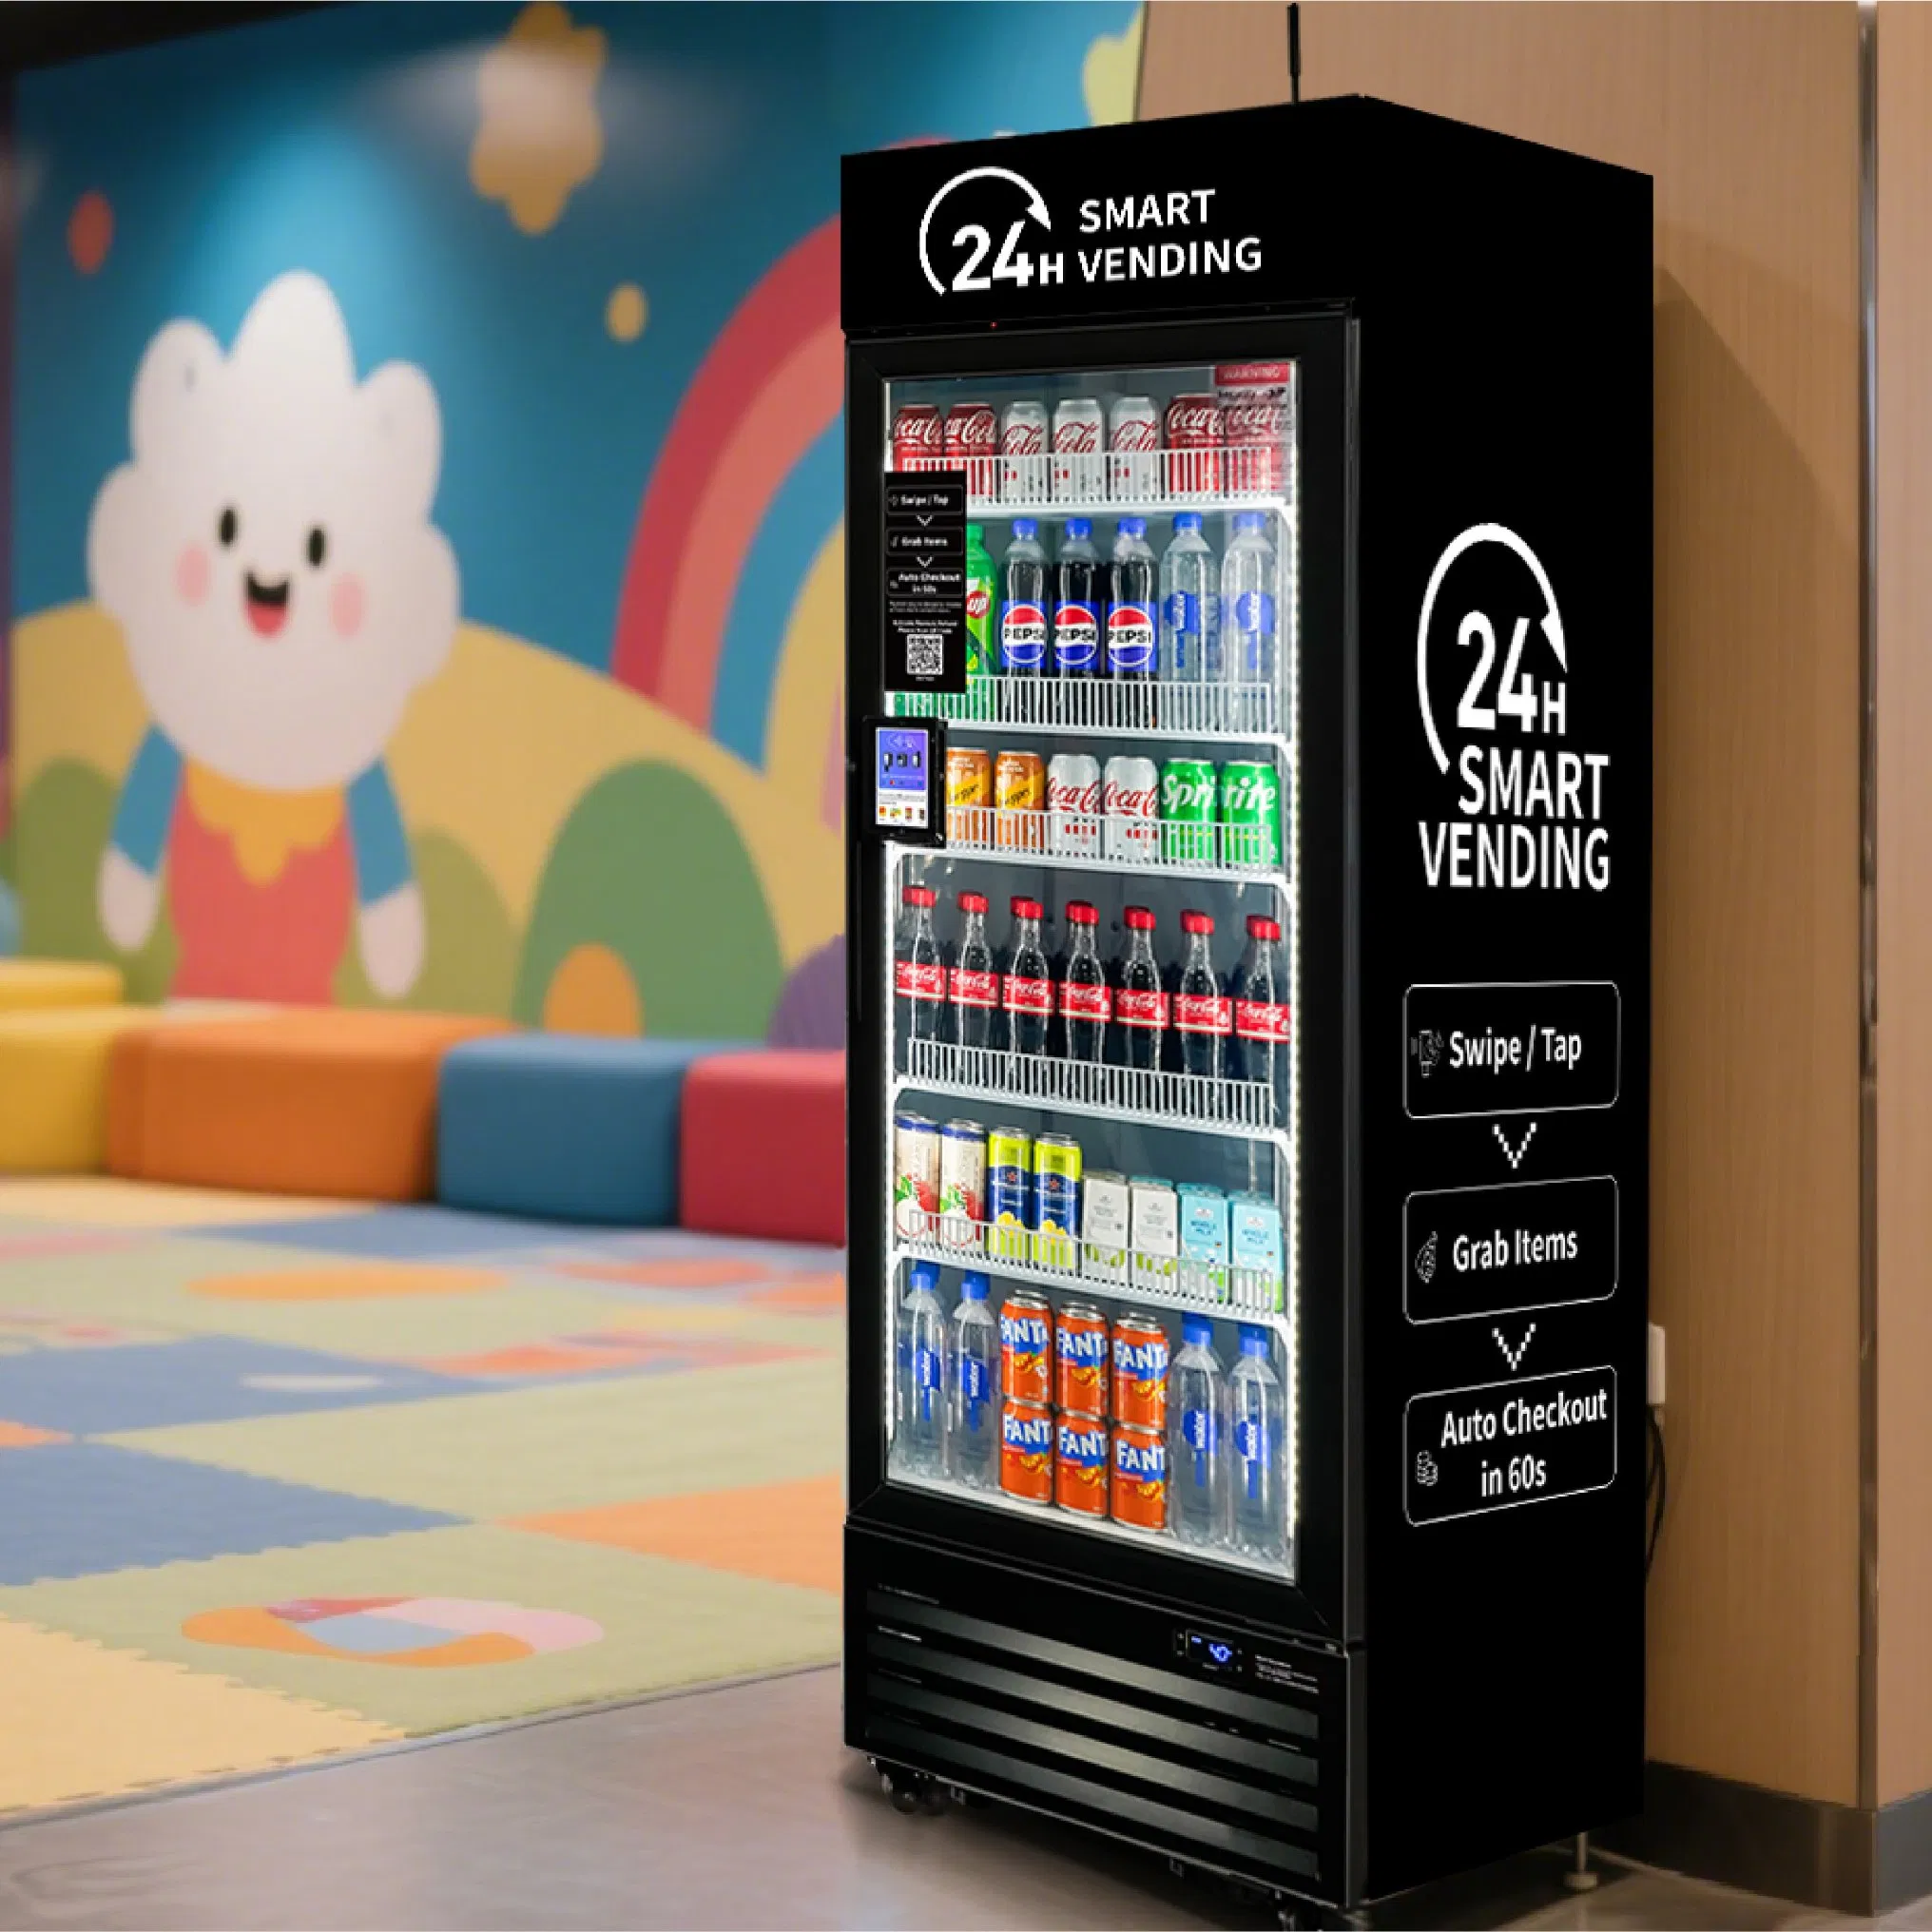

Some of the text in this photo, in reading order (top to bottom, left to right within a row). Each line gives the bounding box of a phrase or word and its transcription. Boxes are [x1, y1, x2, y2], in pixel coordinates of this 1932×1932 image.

[1079, 189, 1216, 233] SMART
[952, 220, 1064, 291] 24H
[1077, 237, 1262, 282] VENDING
[1456, 609, 1568, 736] 24H
[1458, 744, 1610, 820] SMART
[1418, 821, 1610, 892] VENDING
[1449, 1024, 1582, 1074] Swipe / Tap
[1453, 1229, 1578, 1273] Grab Items
[1440, 1390, 1608, 1449] Auto Checkout
[1481, 1455, 1548, 1497] in 60s
